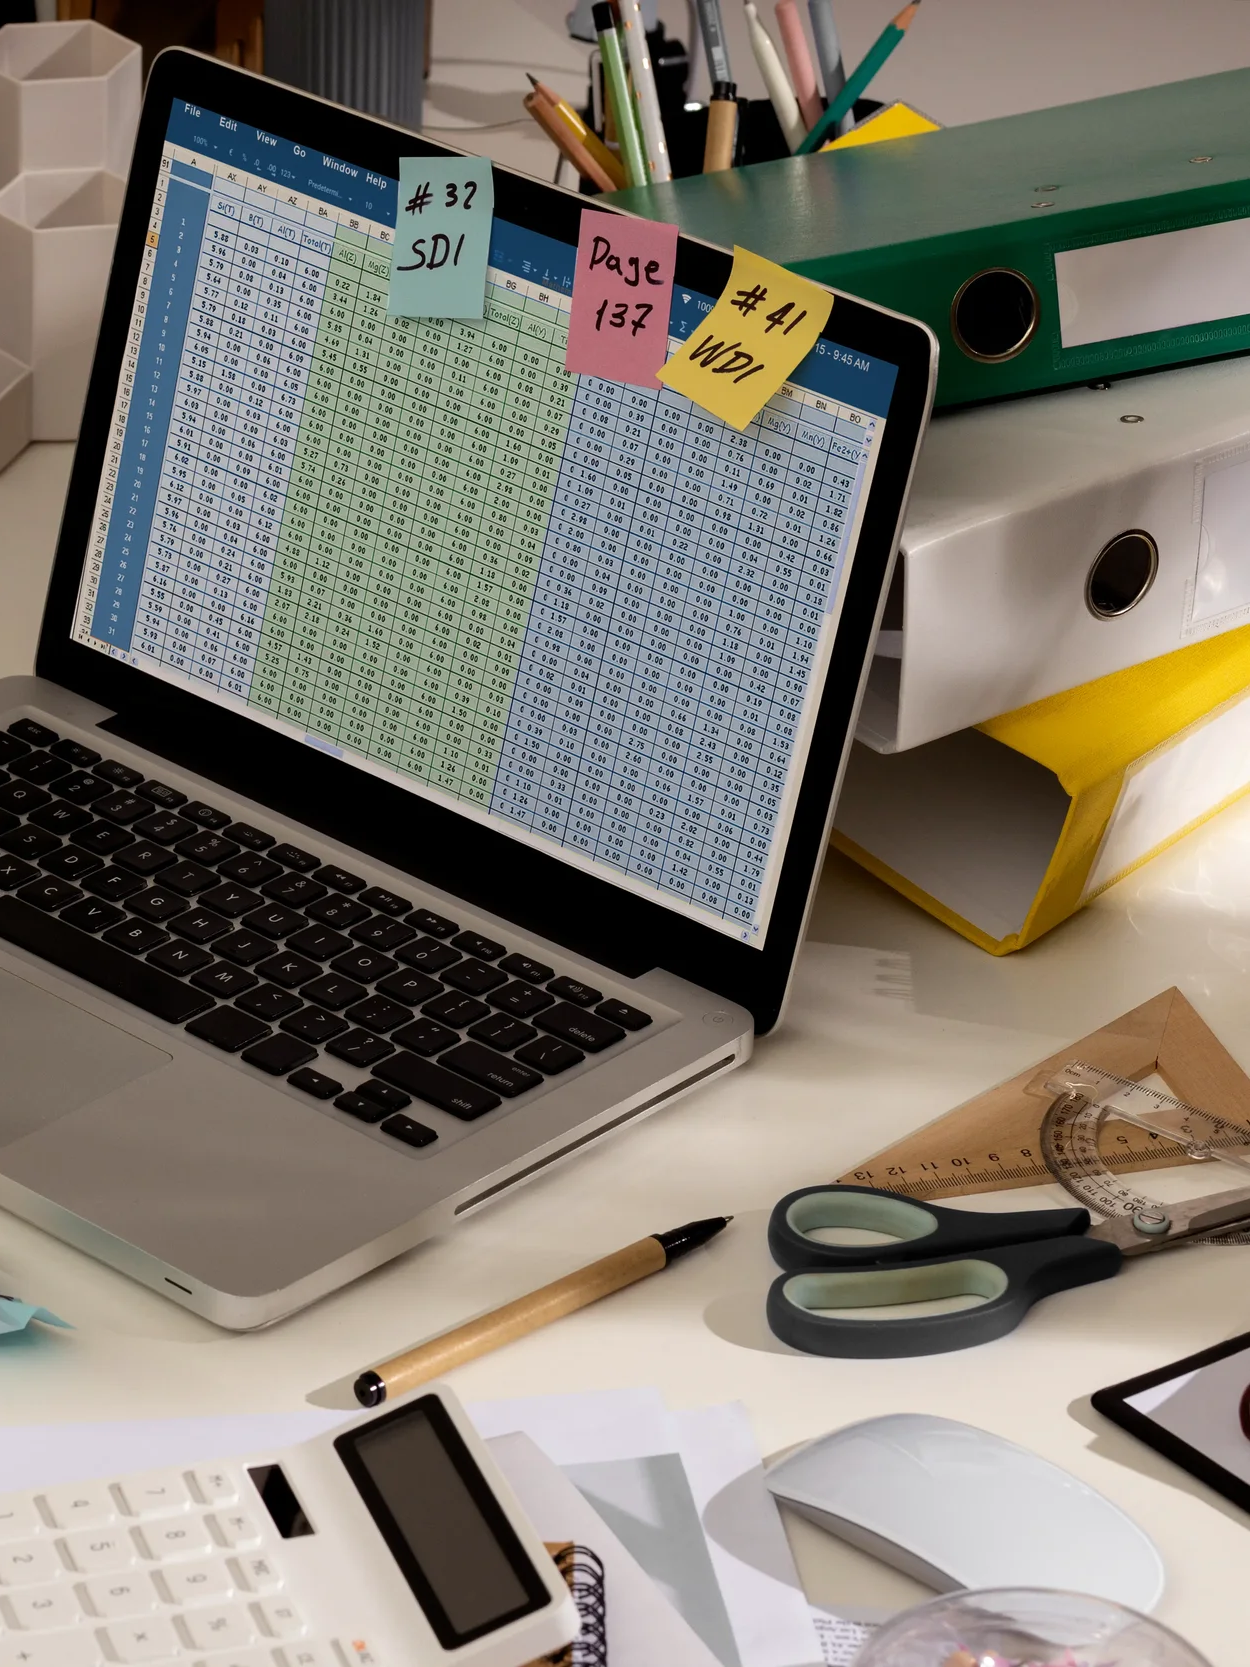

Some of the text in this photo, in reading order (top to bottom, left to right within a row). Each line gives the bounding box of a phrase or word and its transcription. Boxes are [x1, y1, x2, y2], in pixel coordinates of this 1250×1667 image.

[184, 103, 388, 190] File Edit View Go Window Help
[194, 136, 208, 146] 100%
[280, 168, 291, 178] 123
[365, 202, 372, 210] 10
[191, 158, 390, 241] A AX AY AZ BA BB BC
[218, 202, 234, 216] Si(T)
[248, 214, 264, 228] B(T)
[143, 244, 226, 285] 8 5.96
[150, 235, 320, 279] 5 6.00
[396, 233, 466, 270] SDI
[588, 236, 665, 286] Page
[140, 258, 224, 299] 9 5.79
[145, 263, 150, 271] 7
[204, 286, 220, 299] 5.77
[506, 280, 549, 303] BG BH
[138, 305, 145, 314] 10
[330, 305, 379, 319] 6.00 1.26
[596, 299, 654, 336] 137
[730, 284, 808, 336] # 41
[133, 332, 140, 342] 12
[327, 321, 507, 352] 5.85 3.94 6.00
[457, 342, 473, 354] 1.27
[355, 348, 370, 360] 1.31
[689, 334, 765, 384] WDI
[814, 342, 870, 372] 15 9:45 AM
[352, 362, 368, 374] 0.55
[781, 386, 861, 423] BM BN BO
[768, 417, 791, 434] Mg(Y)
[802, 430, 825, 448] Mn(Y)
[730, 435, 850, 488] 2.38 0.43
[721, 479, 738, 491] 1.49
[727, 450, 846, 503] 0.76 1.71
[758, 478, 843, 517] 0.69 1.82
[128, 506, 137, 516] 22
[718, 493, 836, 547] 0.71 0.72 1.26
[748, 522, 764, 535] 1.31
[672, 538, 755, 578] 0.22 2.32
[27, 726, 42, 735] esc
[257, 693, 454, 786] 6.00 6.00 1.47
[625, 751, 780, 793] 2.60 2.55 0.35
[753, 823, 770, 835] 0.73
[13, 790, 27, 799] Q
[52, 809, 71, 820] W
[96, 831, 111, 840] E
[138, 851, 152, 859] R
[182, 871, 195, 880] T
[226, 893, 240, 901] Y
[268, 914, 284, 923] U
[743, 865, 760, 877] 1.79
[672, 864, 754, 905] 1.42 0.13
[0, 865, 16, 875] X
[44, 887, 58, 896] C
[87, 907, 102, 917] V
[128, 929, 143, 938] B
[172, 950, 189, 960] N
[215, 972, 234, 982] M
[23, 835, 37, 843] S
[64, 855, 79, 864] D
[107, 876, 122, 885] F
[150, 897, 165, 906] G
[192, 918, 209, 928] H
[281, 962, 298, 972] K
[327, 985, 338, 993] L
[568, 1026, 596, 1042] delete
[487, 1072, 514, 1088] return
[511, 1066, 531, 1078] enter
[451, 1097, 473, 1110] shift
[1060, 1104, 1074, 1114] 170
[1055, 1117, 1066, 1127] 160
[1053, 1130, 1063, 1141] 150
[1116, 1136, 1129, 1144] 5
[854, 1149, 1032, 1180] 13 12 11 10 9 8
[1070, 1171, 1084, 1184] 120
[1082, 1185, 1097, 1196] 110
[1099, 1196, 1116, 1208] 100
[145, 1487, 166, 1496] 7
[12, 1530, 186, 1564] 2 8
[32, 1599, 54, 1609] 3
